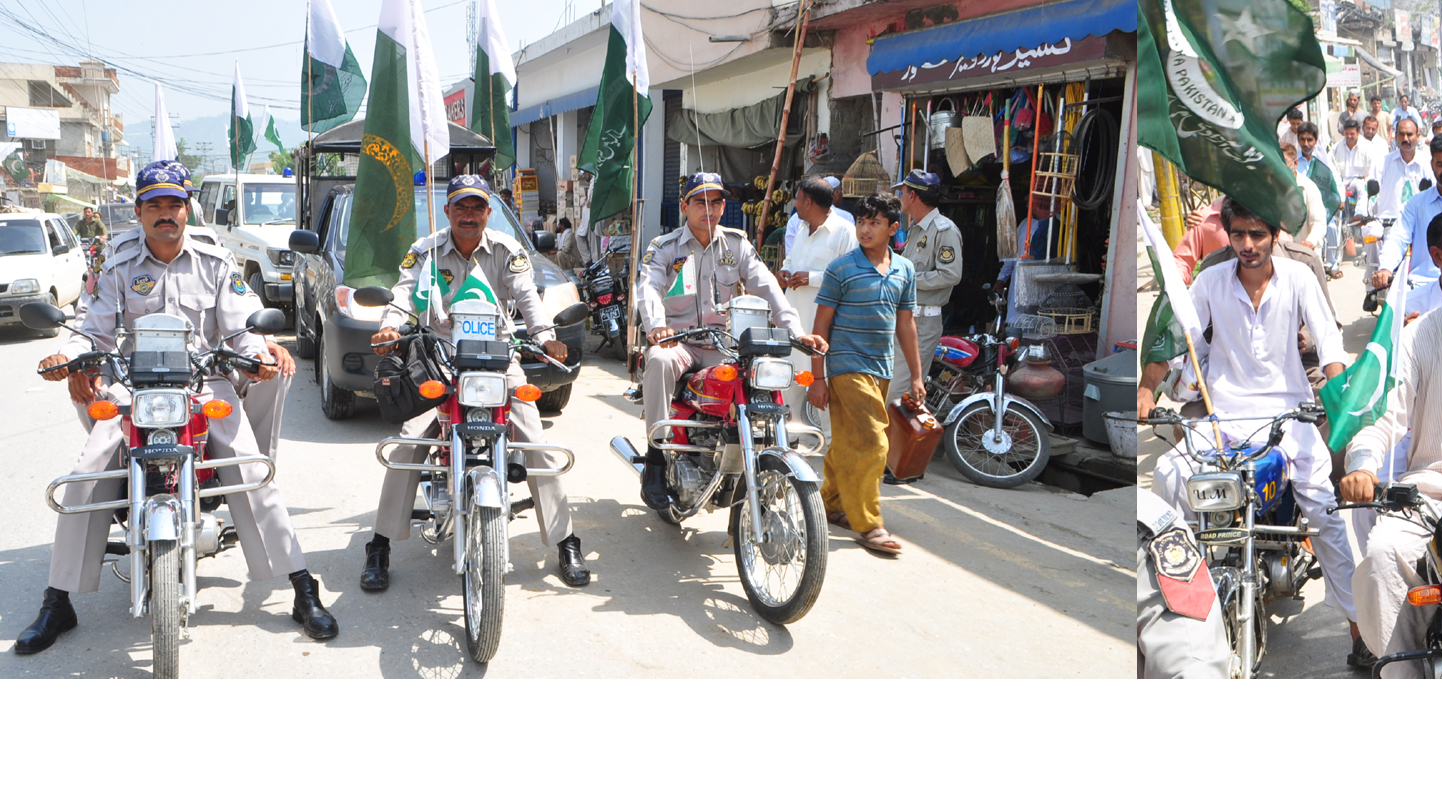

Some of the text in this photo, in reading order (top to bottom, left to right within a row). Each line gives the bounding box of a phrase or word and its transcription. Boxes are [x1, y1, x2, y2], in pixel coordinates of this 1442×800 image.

[1175, 68, 1228, 118] PAKISTAN
[1262, 481, 1276, 502] 10
[1217, 531, 1241, 539] PRINCE
